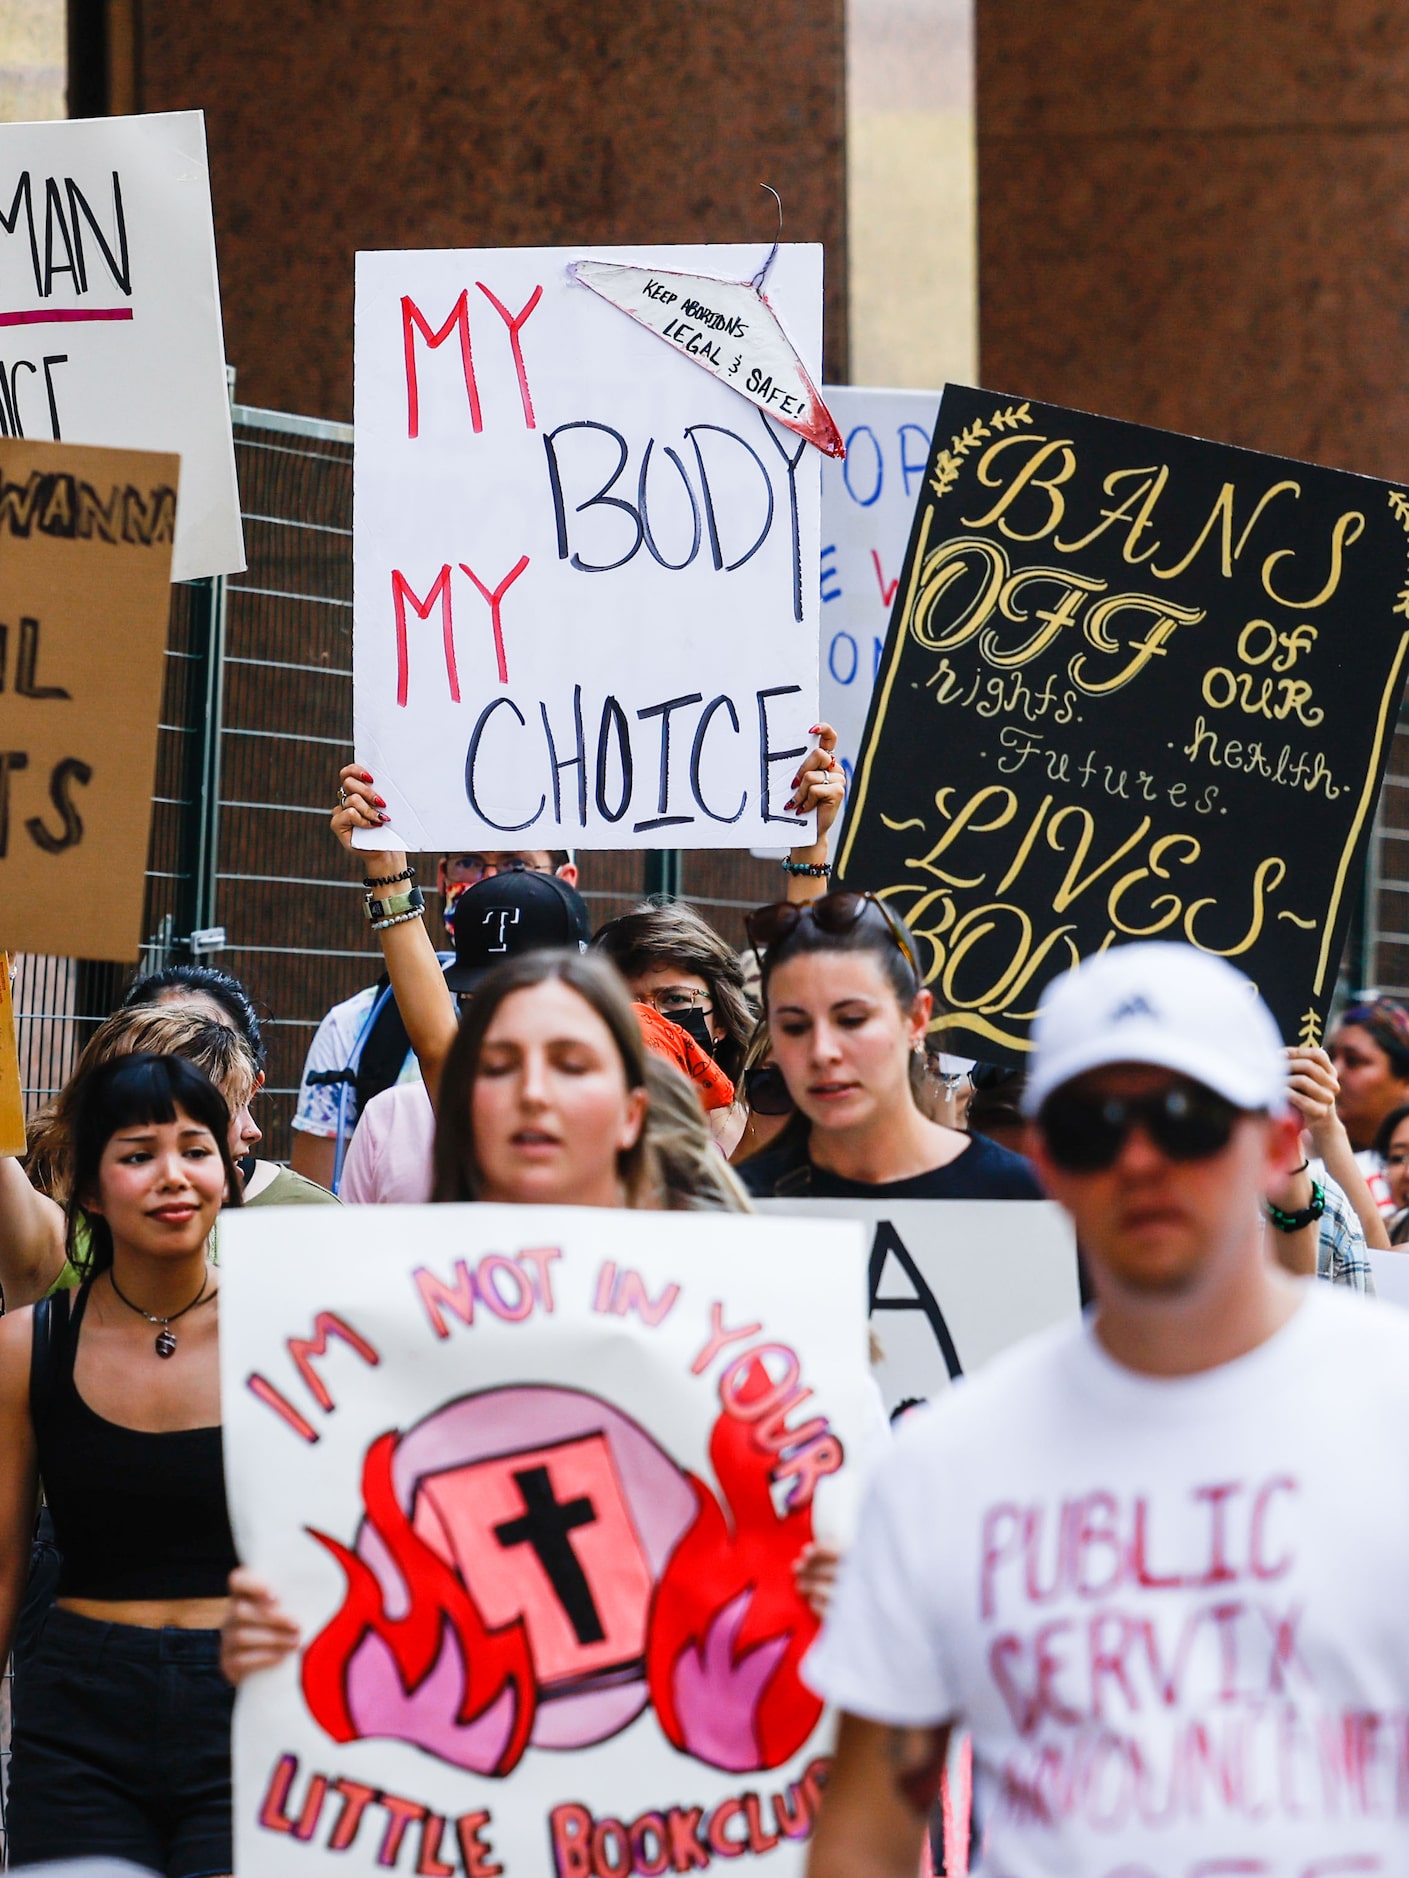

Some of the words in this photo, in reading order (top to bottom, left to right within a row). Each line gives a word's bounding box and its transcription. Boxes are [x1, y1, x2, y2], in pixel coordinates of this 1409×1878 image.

[400, 280, 544, 439] MY
[642, 278, 678, 305] KEEP
[662, 318, 721, 366] LEGAL
[745, 367, 806, 419] SAFE!
[542, 408, 808, 623] BODY
[960, 435, 1365, 608] BANS
[391, 555, 531, 707] MY
[909, 534, 1207, 697] OFF
[465, 684, 809, 832] CHOICE
[246, 1309, 380, 1444] IM
[411, 1246, 563, 1340] NOT
[592, 1260, 682, 1328] IN
[690, 1301, 845, 1510] YOUR
[979, 1474, 1300, 1620] PUBLIC
[258, 1753, 504, 1878] LITTLE
